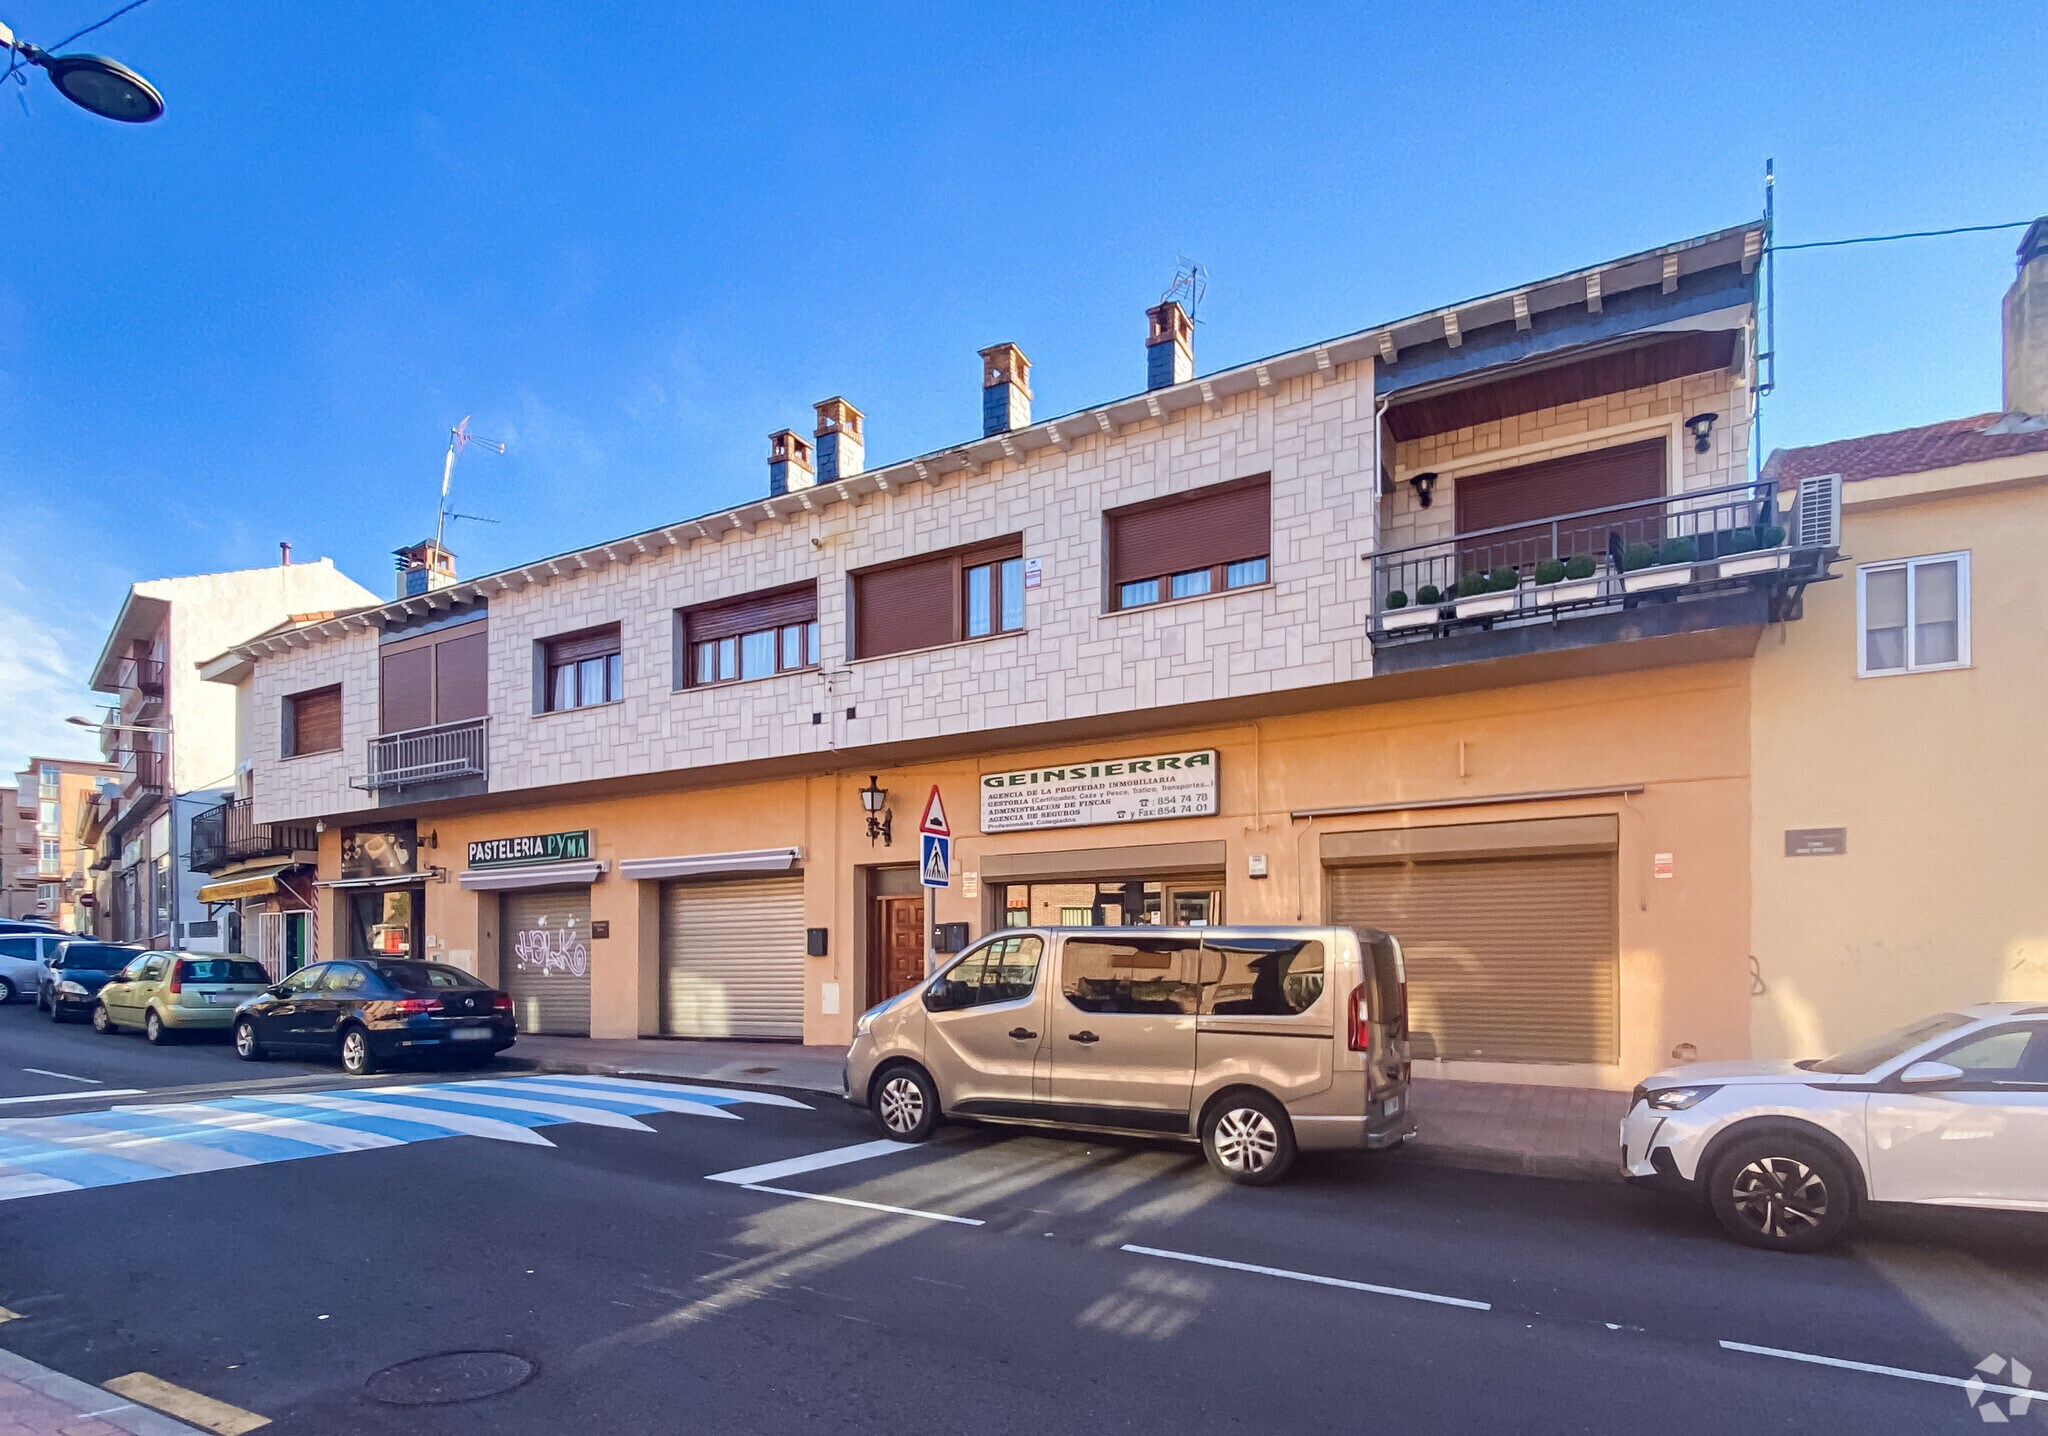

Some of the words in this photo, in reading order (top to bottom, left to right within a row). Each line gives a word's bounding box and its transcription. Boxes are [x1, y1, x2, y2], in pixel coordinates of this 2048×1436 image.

[983, 754, 1210, 788] GEINSIERRA
[988, 791, 1023, 800] AGENCIA
[1055, 783, 1105, 793] PROPIEDAD
[1109, 776, 1176, 788] INMOBILIARIA
[988, 799, 1029, 807] GESTORIA
[1079, 798, 1112, 806] FINCAS
[1157, 796, 1176, 805] 854
[1180, 794, 1192, 803] 74
[1196, 793, 1208, 801] 78
[988, 815, 1024, 823] AGENCIA
[1041, 809, 1081, 817] SEGUROS
[1130, 812, 1135, 820] y
[1157, 806, 1176, 815] 854
[1180, 805, 1192, 813] 74
[1196, 803, 1208, 812] 01
[469, 836, 544, 861] PASTELERIA
[547, 832, 585, 858] PYMA
